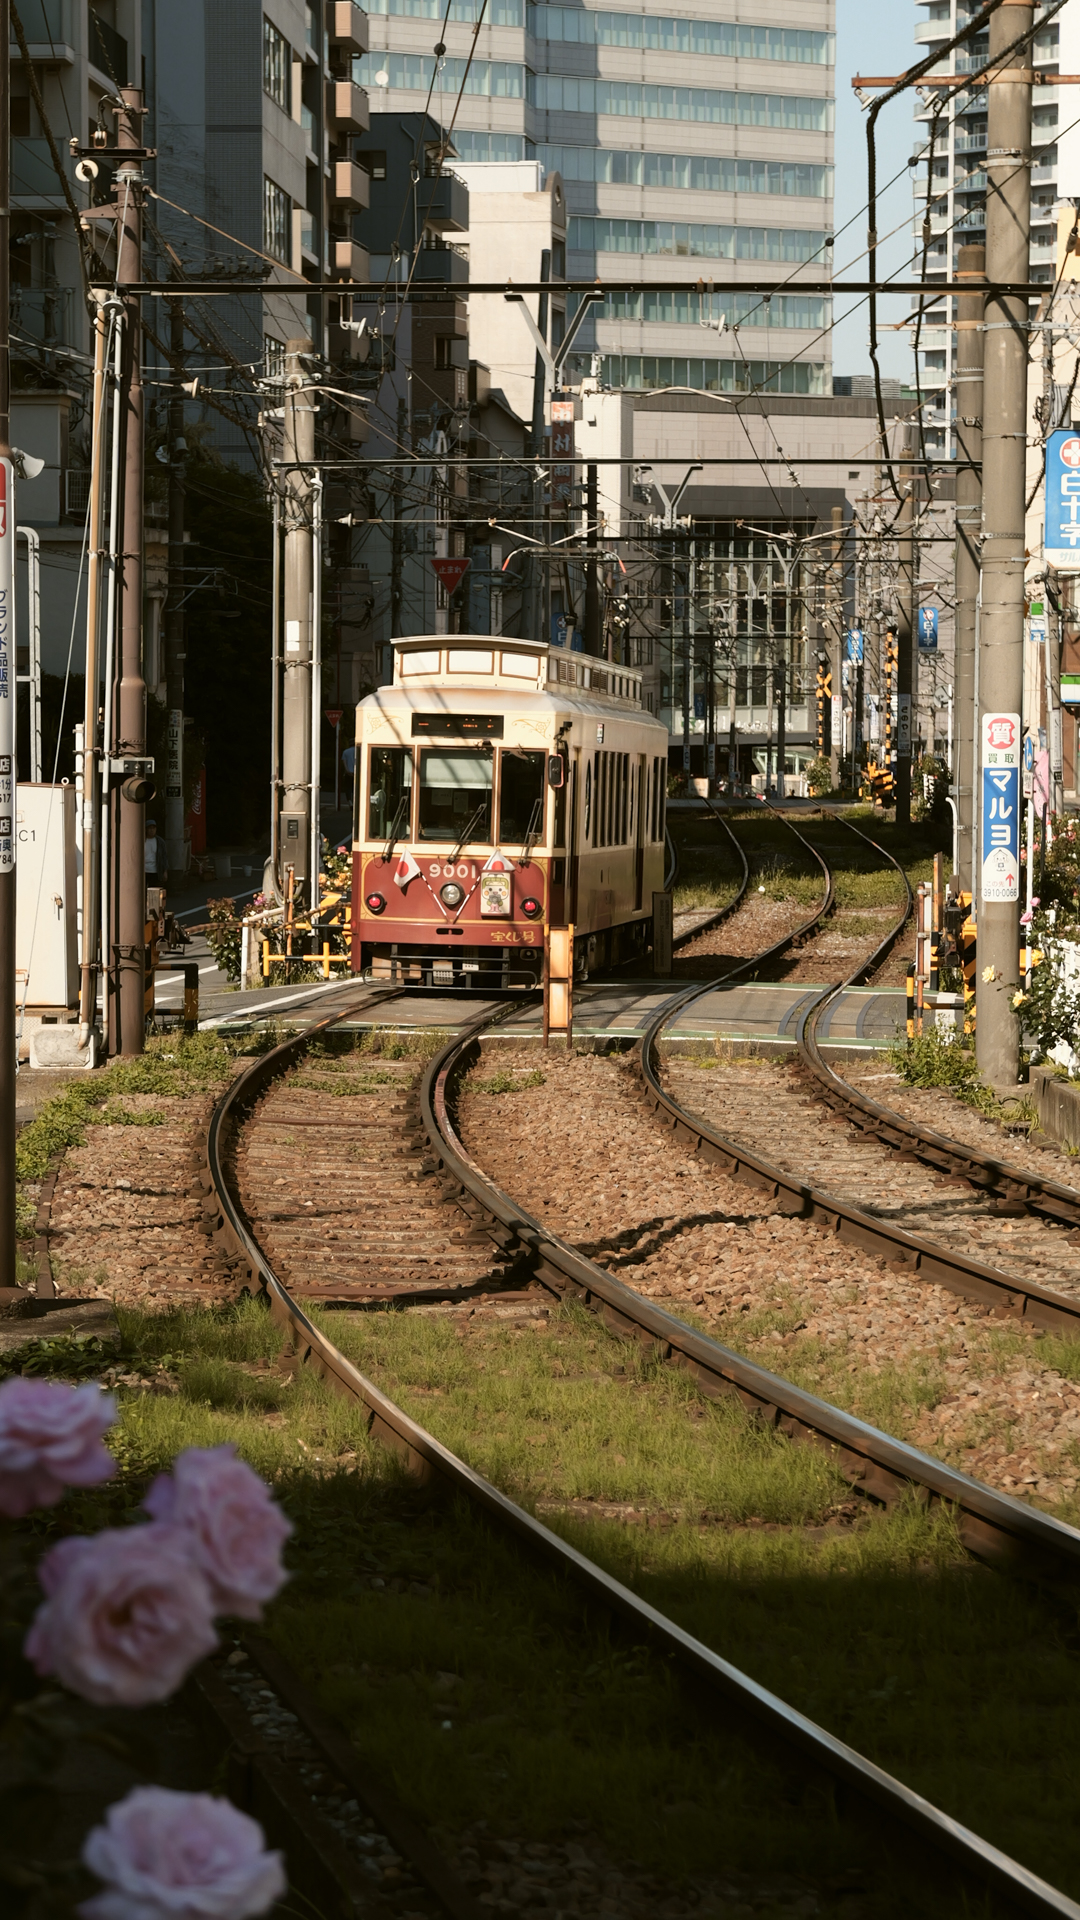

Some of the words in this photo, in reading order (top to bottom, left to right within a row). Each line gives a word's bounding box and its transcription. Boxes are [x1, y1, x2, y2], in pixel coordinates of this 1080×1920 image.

[1060, 470, 1080, 546] 白十字
[1059, 551, 1080, 563] サル
[438, 566, 462, 574] 止まれ
[923, 621, 934, 646] 白十字
[991, 722, 1012, 745] 質
[168, 728, 178, 770] 山下医院
[988, 753, 1014, 763] 買取
[0, 778, 11, 791] 1分
[989, 770, 1012, 846] マルヨ
[0, 854, 12, 865] 84
[429, 863, 476, 878] 9001
[983, 888, 1017, 897] 3910-0066
[490, 931, 535, 943] 宝くじ号
